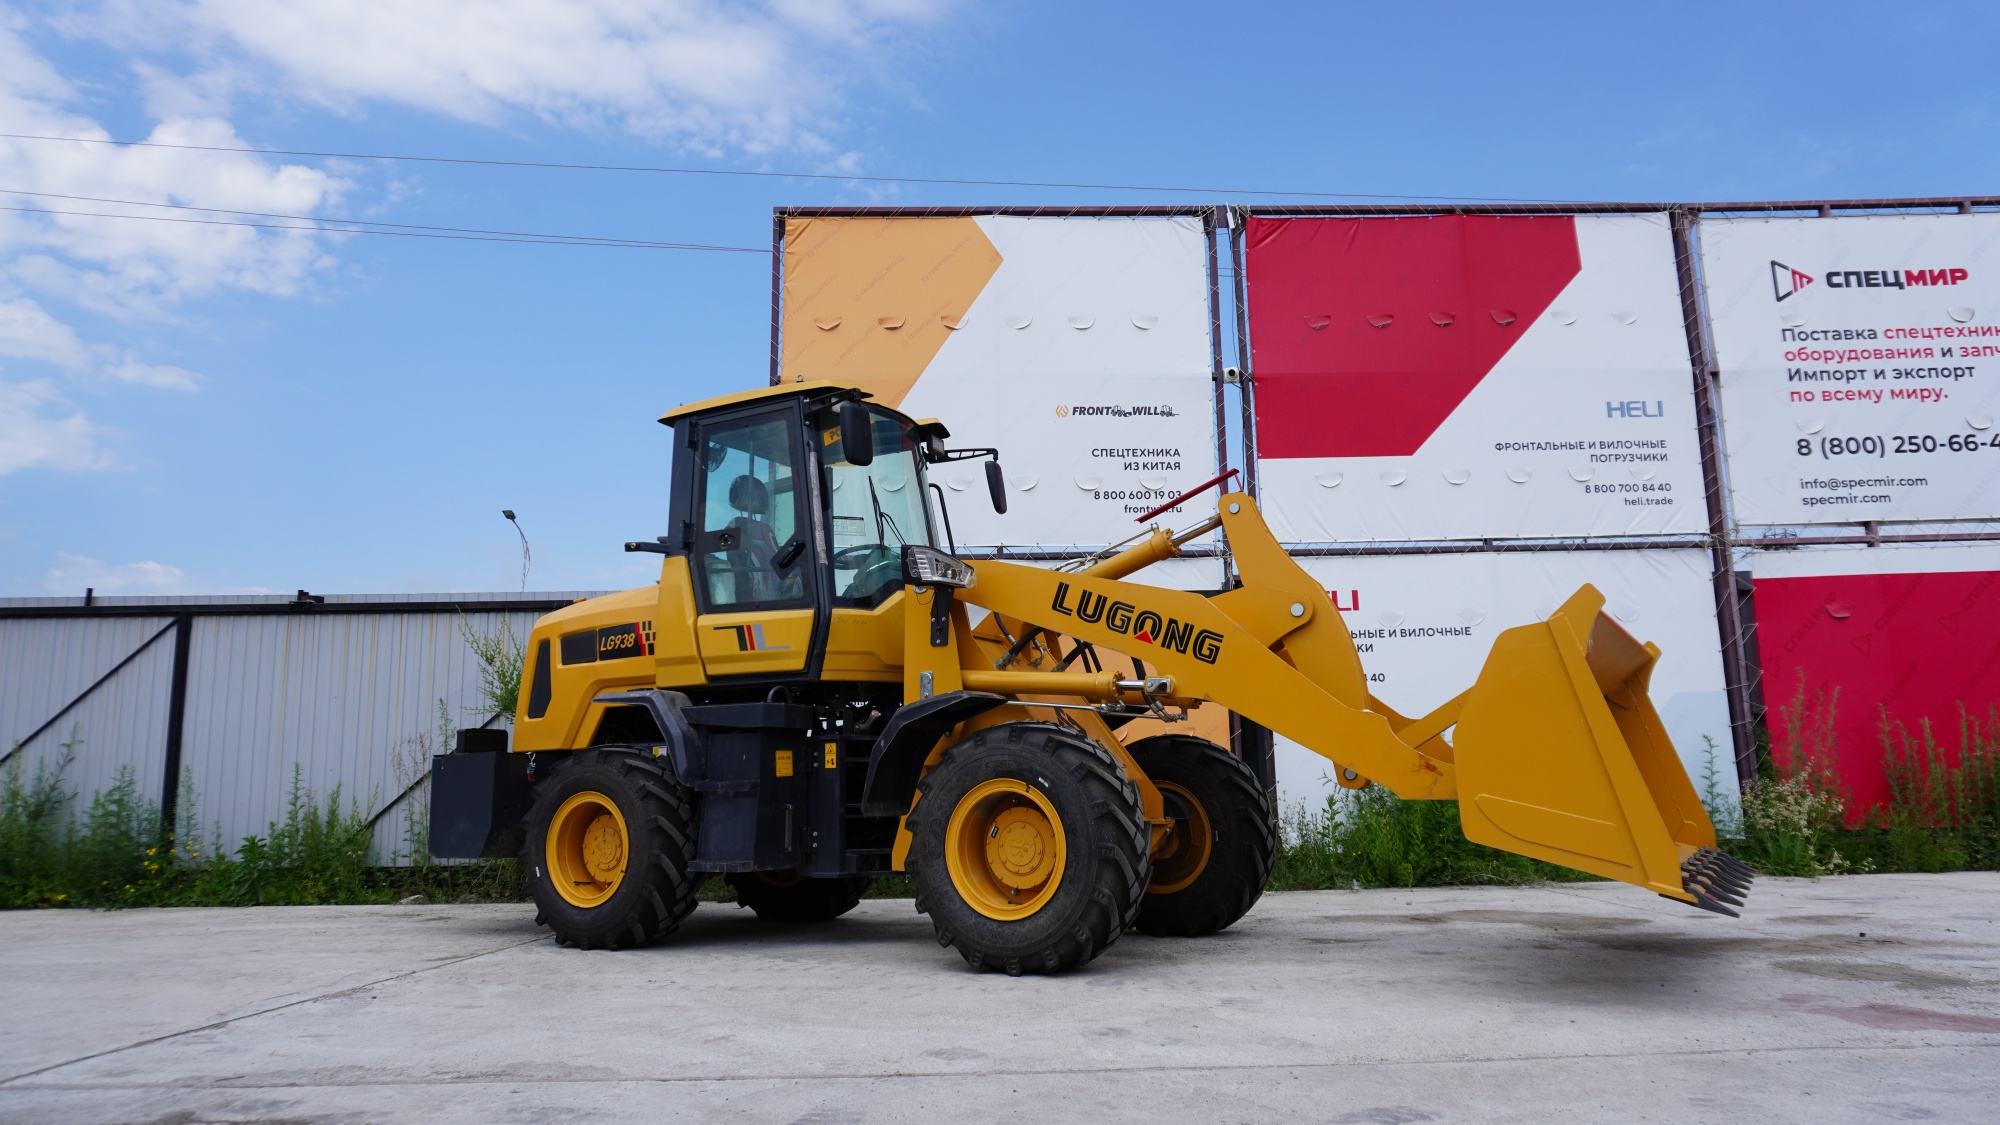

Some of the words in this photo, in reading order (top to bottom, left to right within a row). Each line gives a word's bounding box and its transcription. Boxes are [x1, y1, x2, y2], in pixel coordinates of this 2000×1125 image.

[1826, 268, 1969, 290] СПЕЦМИР
[1781, 327, 1878, 342] Поставка
[1784, 346, 1934, 364] оборудования
[1941, 347, 1954, 358] и
[1788, 367, 1867, 384] Импорт
[1874, 369, 1886, 381] и
[1892, 365, 1975, 381] экспорт
[1790, 390, 1815, 402] по
[1822, 388, 1883, 403] всему
[1890, 387, 1948, 403] миру.
[1072, 406, 1112, 416] FRONT
[1132, 406, 1161, 416] WILL
[1606, 400, 1664, 418] HELI
[1495, 441, 1586, 452] ФРОНТАЛЬНЫЕ
[1588, 441, 1597, 450] И
[1599, 440, 1667, 450] ВИЛОЧНЫЕ
[1797, 438, 1812, 456] 8
[1821, 435, 1886, 460] (800)
[1892, 433, 2000, 453] 250-66-4
[1091, 448, 1181, 459] СПЕЦТЕХНИКА
[1590, 453, 1668, 463] ПОГРУЗЧИКИ
[1123, 461, 1140, 471] ИЗ
[1142, 461, 1181, 471] КИТАЯ
[1585, 484, 1592, 494] 8
[1594, 484, 1616, 494] 800
[1618, 483, 1640, 493] 700
[1642, 483, 1656, 493] 84
[1657, 483, 1672, 492] 40
[1800, 476, 1928, 490] info@specmir.com
[1093, 490, 1101, 500] 8
[1103, 490, 1126, 500] 800
[1128, 490, 1151, 500] 600
[1153, 490, 1165, 500] 19
[1167, 490, 1182, 500] 03
[1624, 497, 1674, 506] heli.trade
[1802, 493, 1892, 507] specmir.com
[1052, 582, 1224, 665] LUGONG
[1388, 629, 1397, 638] И
[1400, 627, 1472, 638] ВИЛОЧНЫЕ
[600, 632, 636, 651] LG938
[1370, 673, 1386, 683] 40
